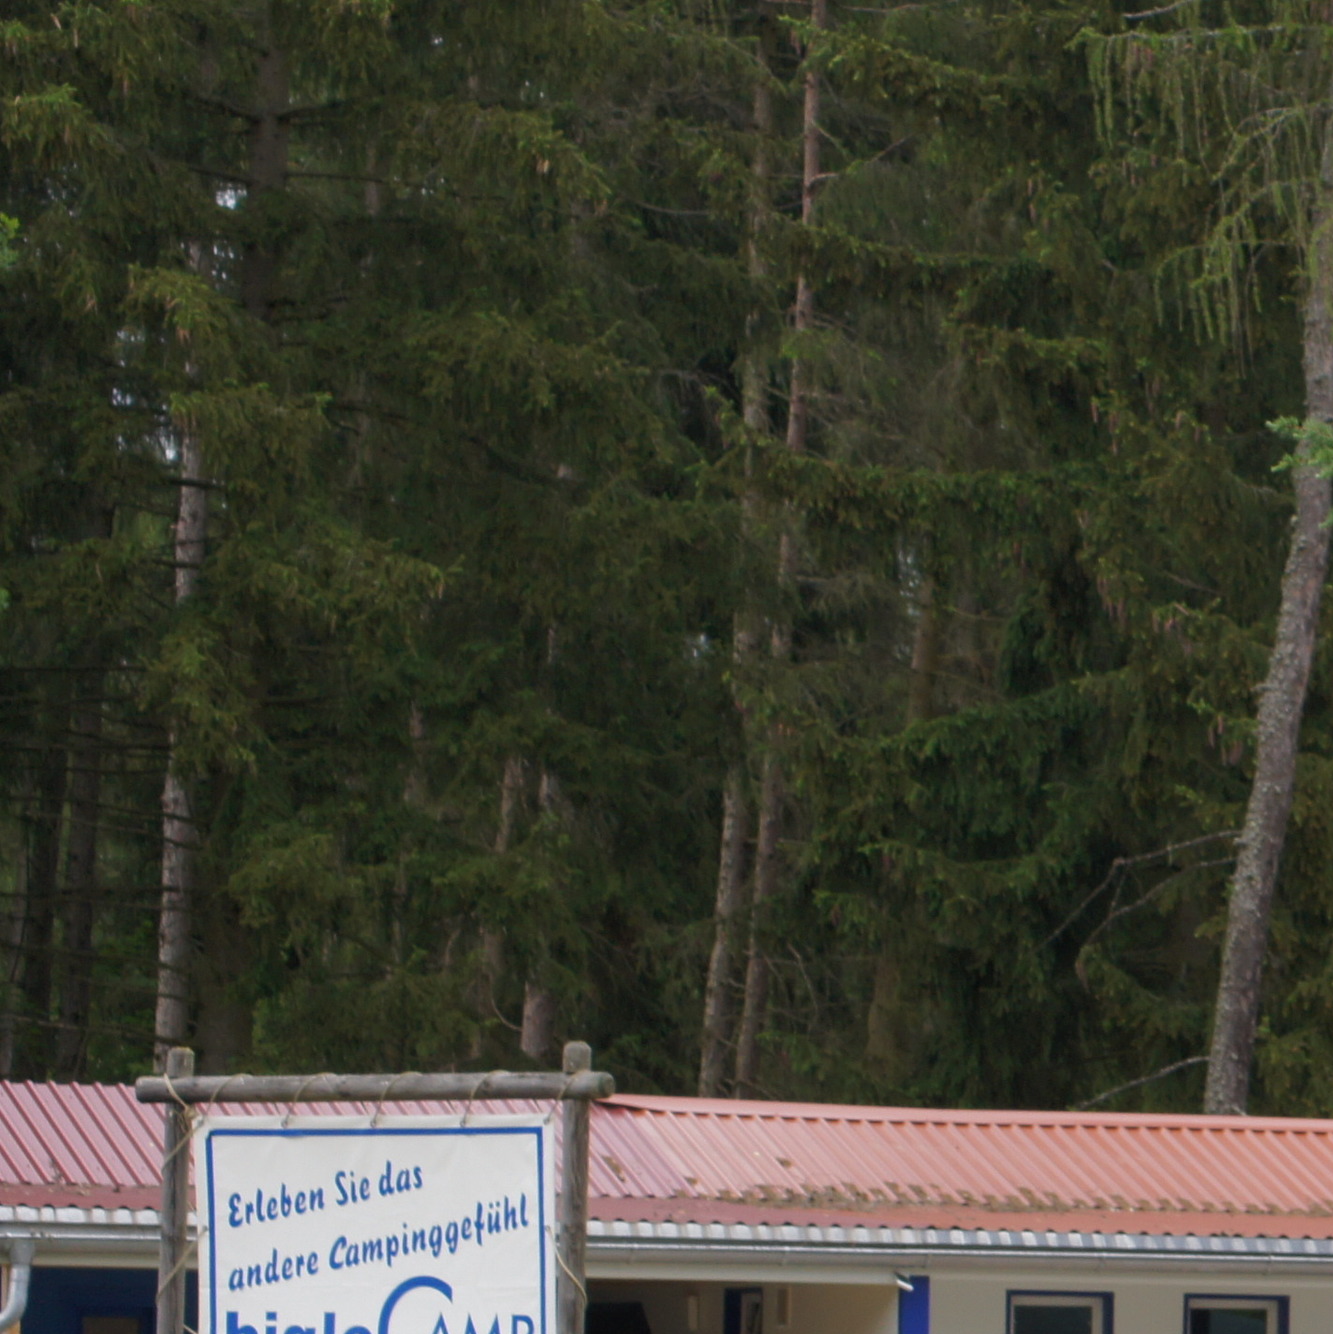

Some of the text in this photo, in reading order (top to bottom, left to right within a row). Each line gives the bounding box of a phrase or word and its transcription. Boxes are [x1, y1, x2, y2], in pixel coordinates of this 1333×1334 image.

[228, 1161, 424, 1228] Erleben Sie das
[228, 1194, 529, 1291] andere Campinggefühl
